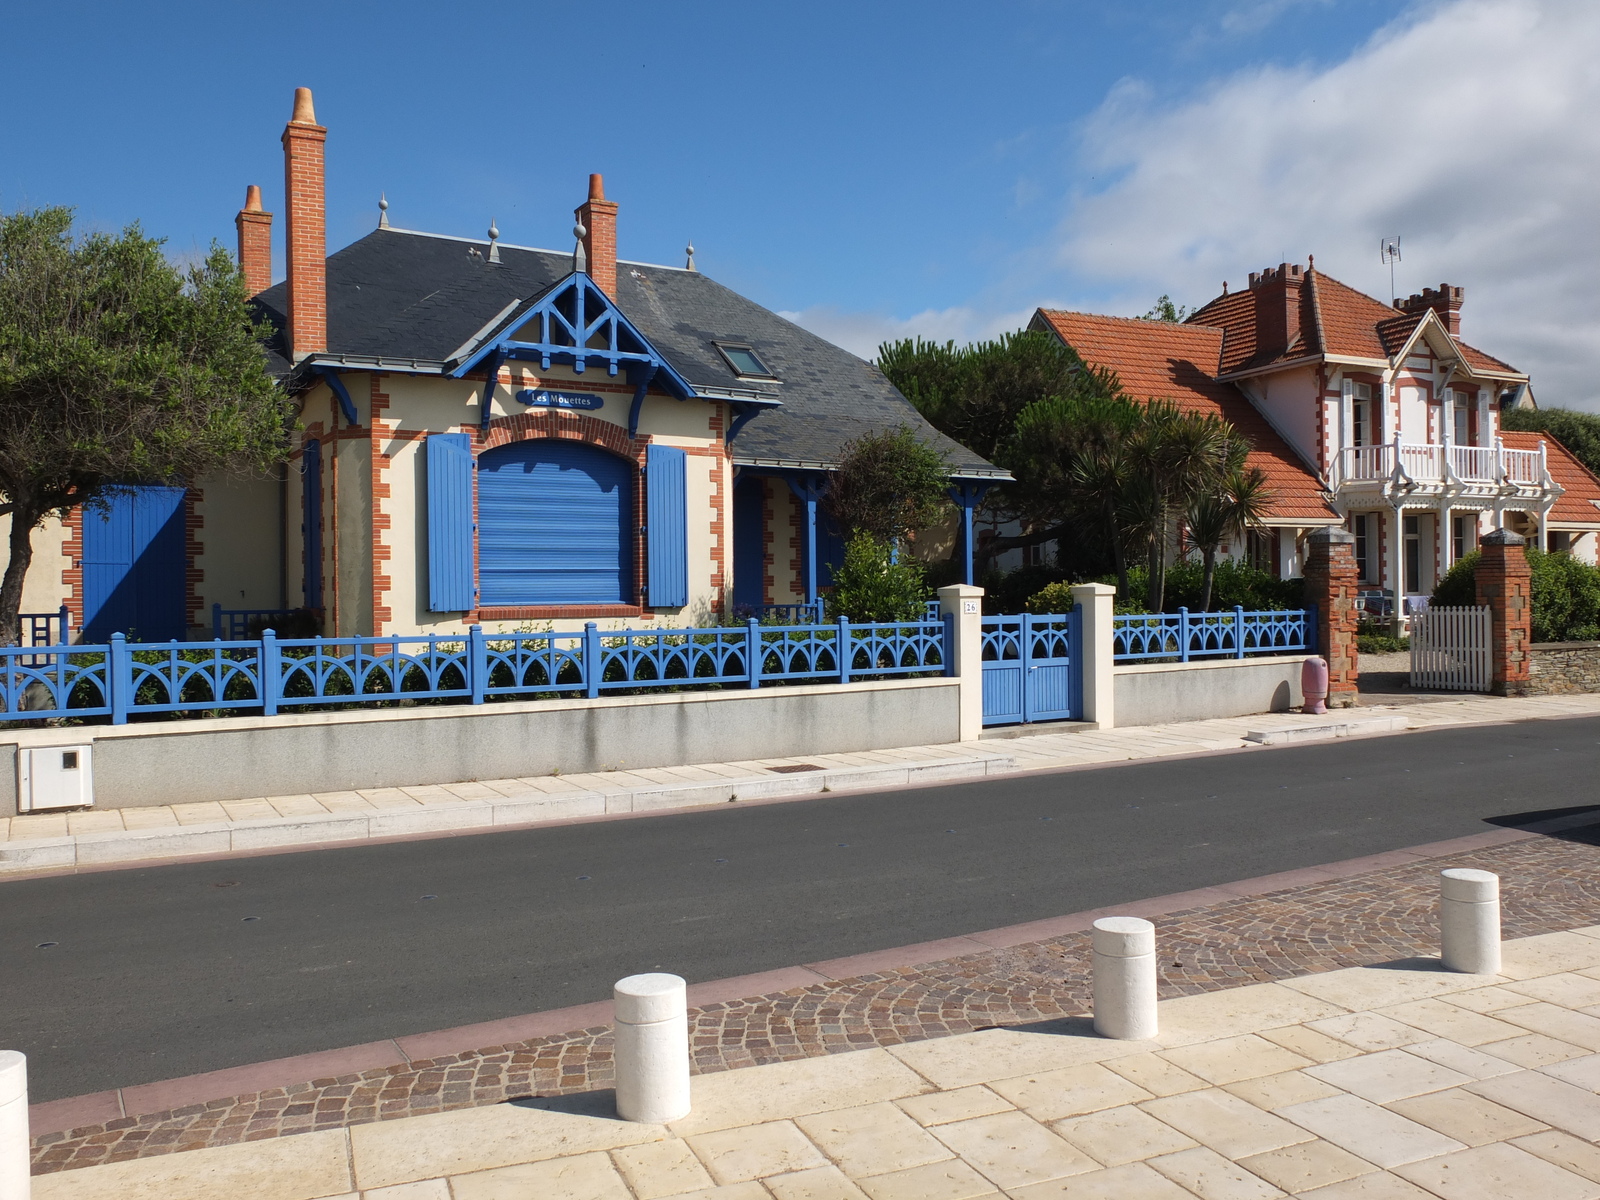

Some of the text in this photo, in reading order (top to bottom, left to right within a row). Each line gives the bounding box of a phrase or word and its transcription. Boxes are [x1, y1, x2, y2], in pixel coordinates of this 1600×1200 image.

[532, 393, 591, 405] Les Mouettes
[966, 604, 976, 612] 26
